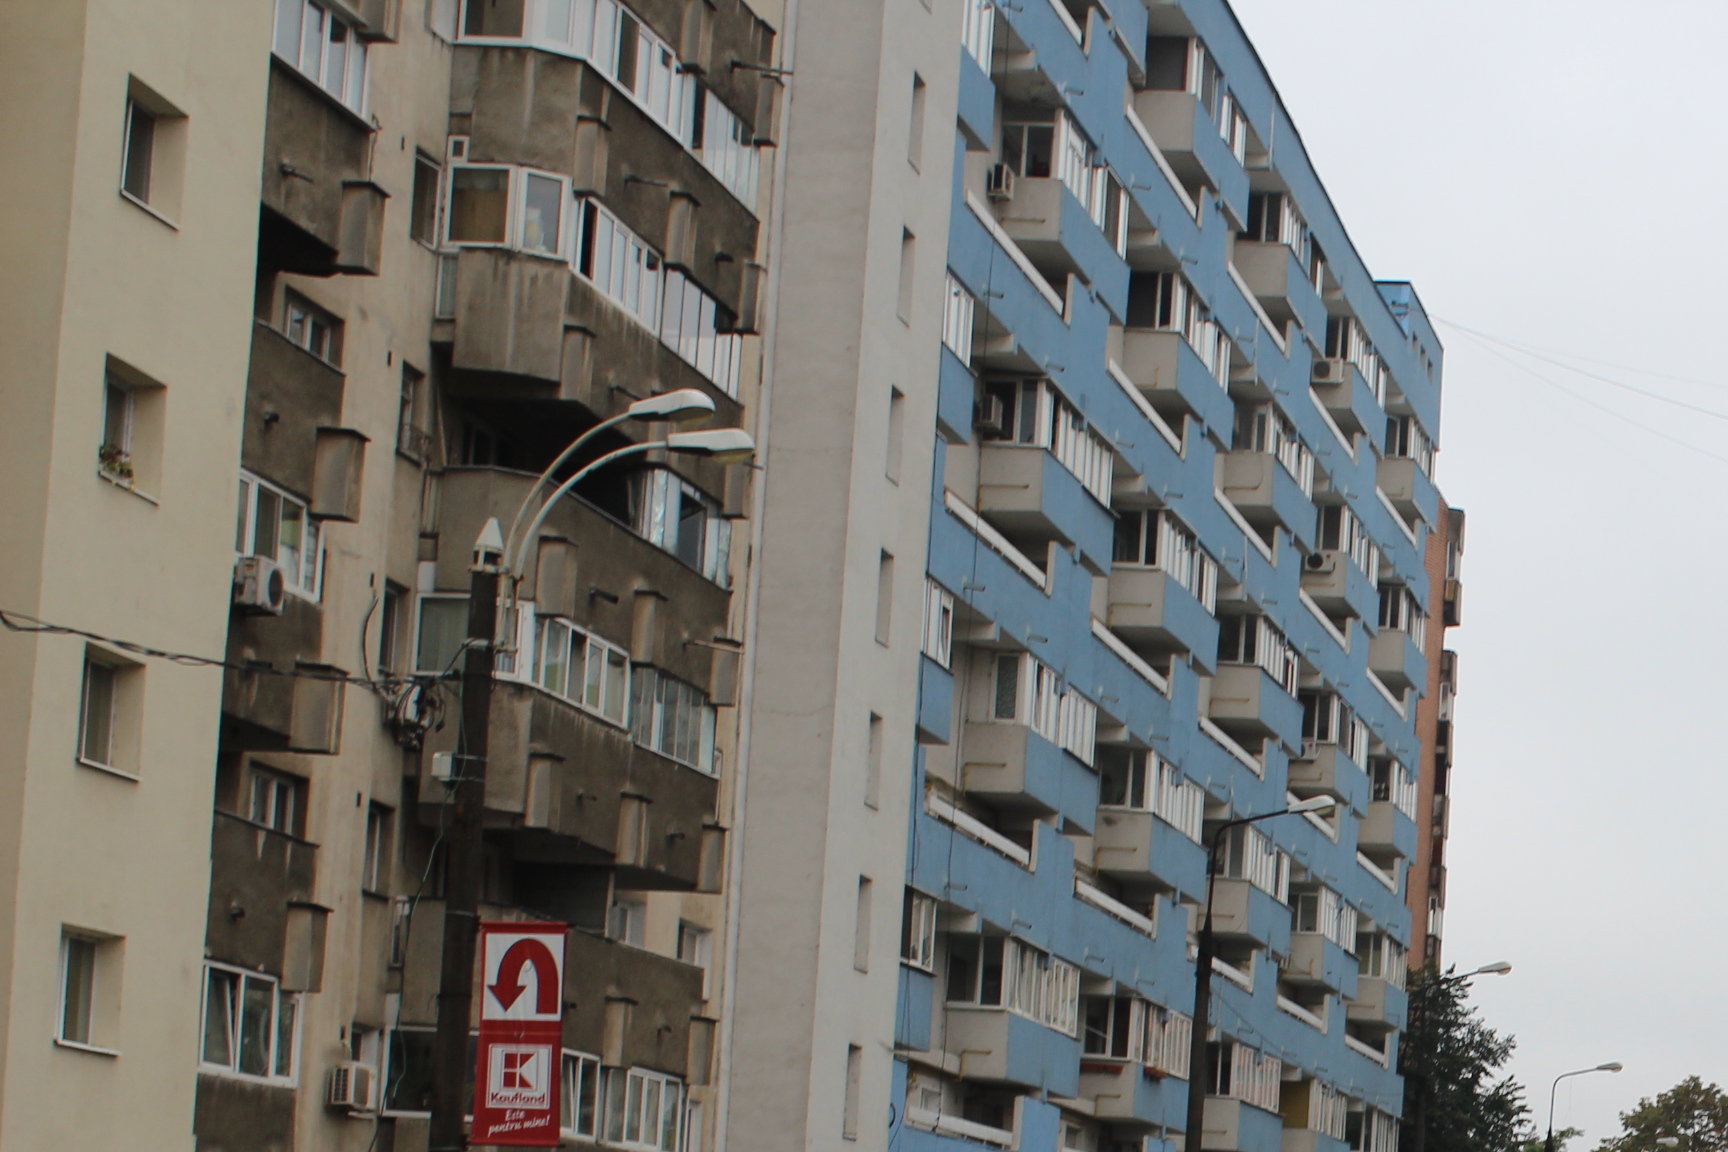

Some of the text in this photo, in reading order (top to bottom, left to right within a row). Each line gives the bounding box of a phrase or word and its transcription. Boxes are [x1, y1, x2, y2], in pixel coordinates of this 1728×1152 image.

[490, 1092, 546, 1104] Kaufland
[505, 1109, 525, 1121] Este
[488, 1114, 551, 1137] pentru mine!
